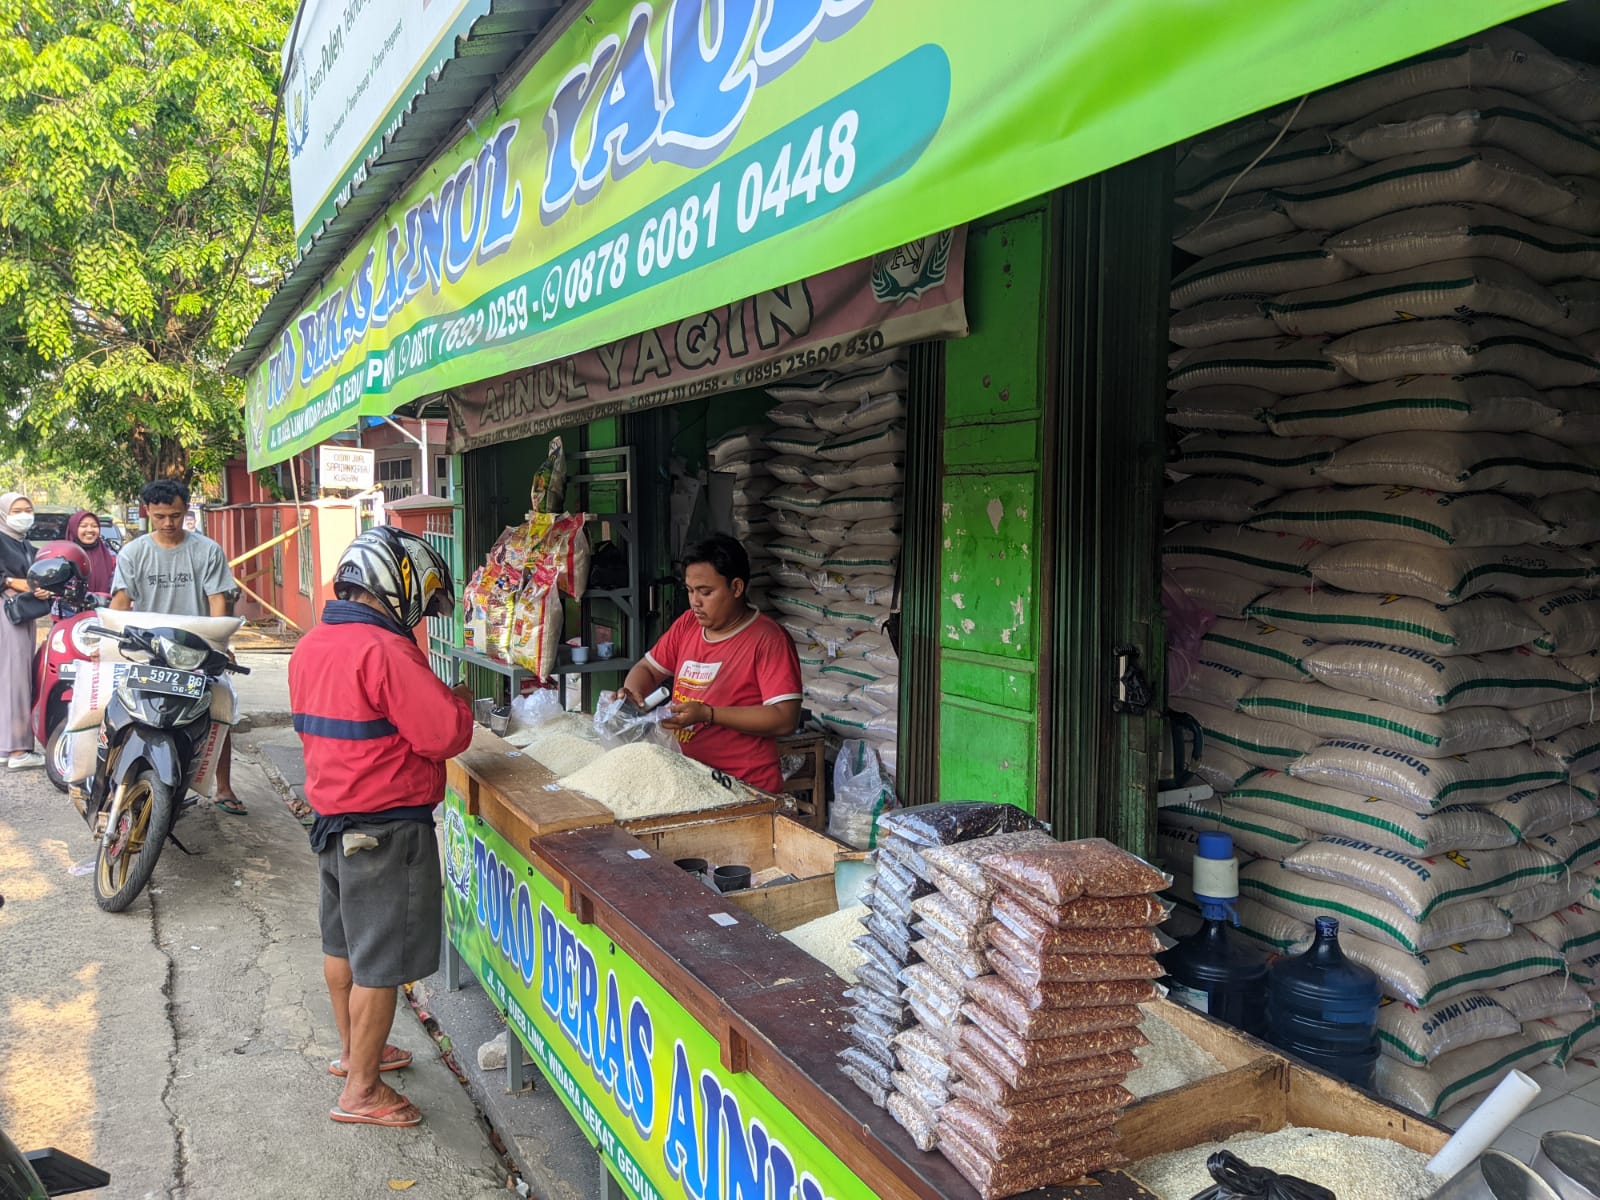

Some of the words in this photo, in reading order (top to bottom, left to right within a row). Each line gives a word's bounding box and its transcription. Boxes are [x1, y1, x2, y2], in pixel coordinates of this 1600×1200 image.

[298, 246, 374, 384] BERAS
[372, 119, 522, 317] AINUL
[410, 323, 438, 368] 0877
[438, 308, 485, 356] 7693
[485, 285, 528, 342] 0259
[564, 232, 629, 309] 0878
[636, 180, 721, 277] 6081
[736, 109, 859, 234] 0448
[480, 361, 588, 426] AINUL
[599, 283, 815, 391] YAQIN
[745, 363, 781, 384] 0895
[787, 344, 840, 372] 23600
[844, 330, 884, 357] 830
[129, 667, 139, 679] A
[150, 669, 180, 684] 5972
[1388, 643, 1446, 673] LUHUR
[1372, 747, 1431, 777] LUHUR
[1318, 834, 1374, 851] SAWAH
[1374, 847, 1431, 882] LUHUR
[473, 836, 537, 986] TOKO
[539, 904, 655, 1137] BERAS
[1422, 1002, 1462, 1035] SAWAH
[486, 968, 497, 989] JL.
[497, 982, 507, 1000] TR.
[507, 997, 527, 1029] SUEB
[527, 1026, 548, 1064] LINK.
[548, 1052, 582, 1112] WIDARA
[582, 1099, 616, 1156] DEKAT
